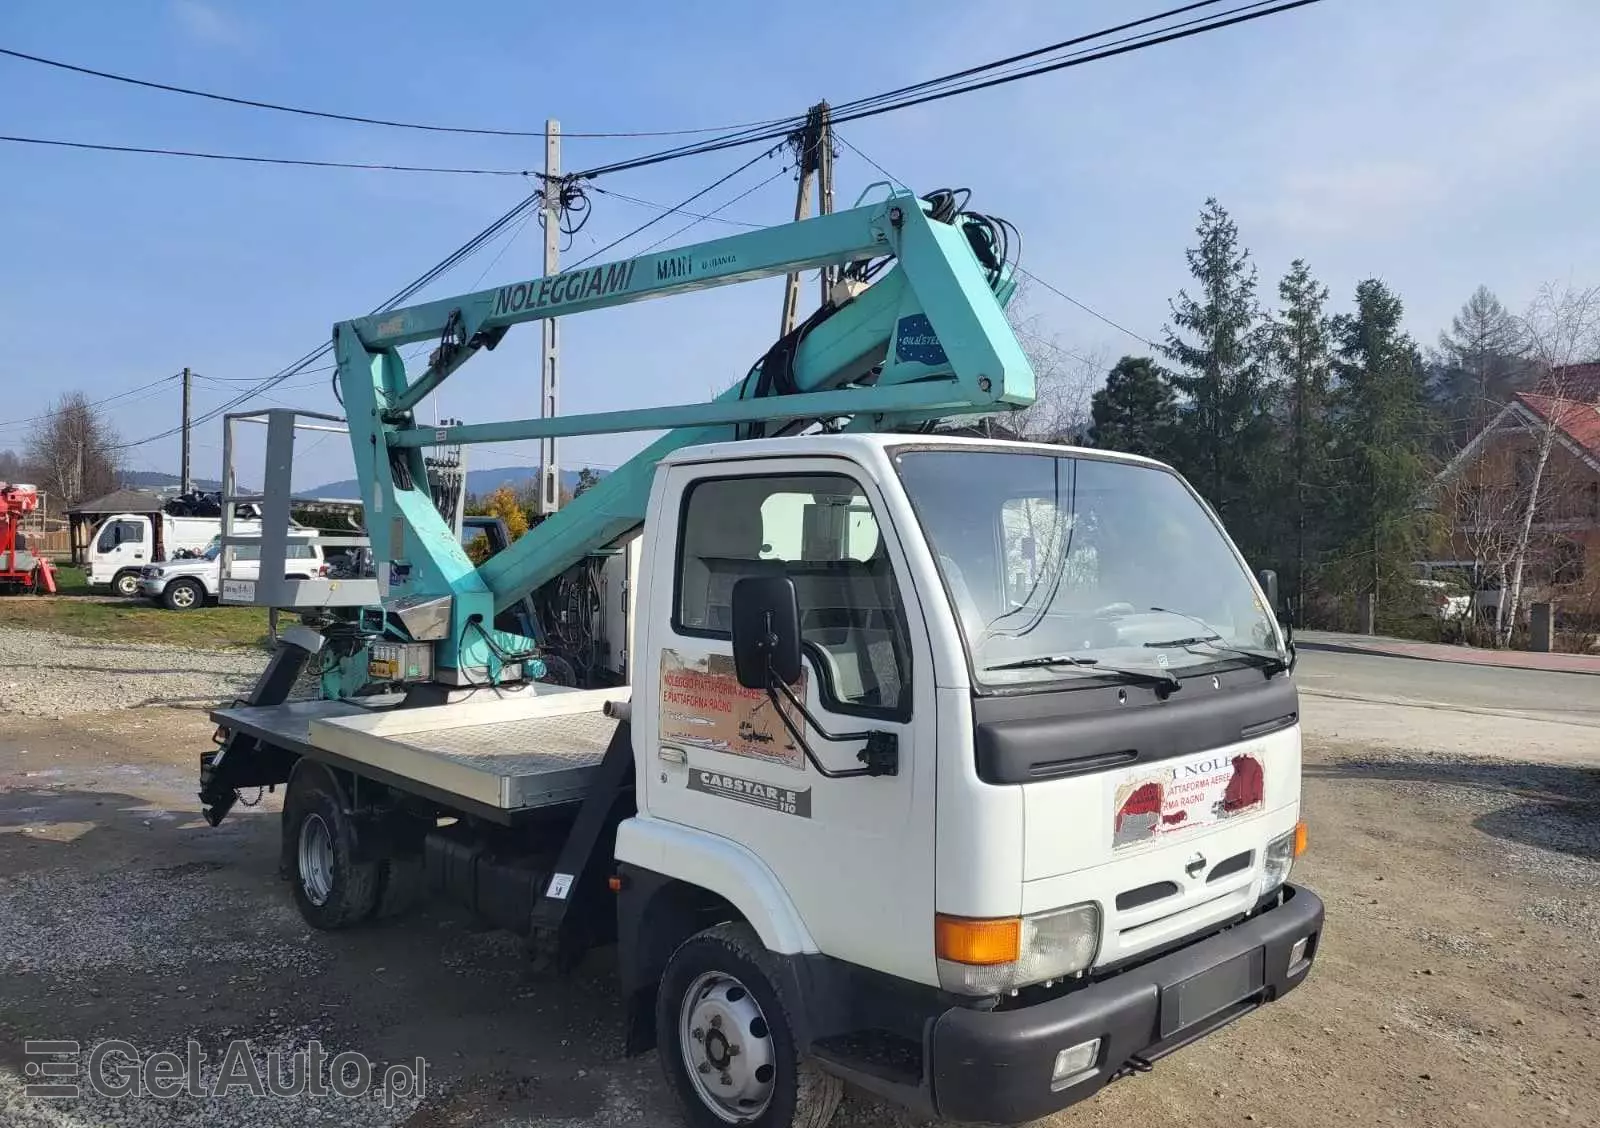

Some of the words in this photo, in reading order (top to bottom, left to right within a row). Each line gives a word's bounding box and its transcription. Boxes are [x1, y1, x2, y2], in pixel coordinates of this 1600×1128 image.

[494, 259, 636, 316] NOLEGGIAMI
[665, 673, 693, 689] NOLEGGIO
[694, 678, 737, 696] PIATTAFORMA
[668, 691, 707, 708] PIATTAFORMA
[779, 802, 796, 814] 110
[1180, 792, 1205, 808] RAGNO
